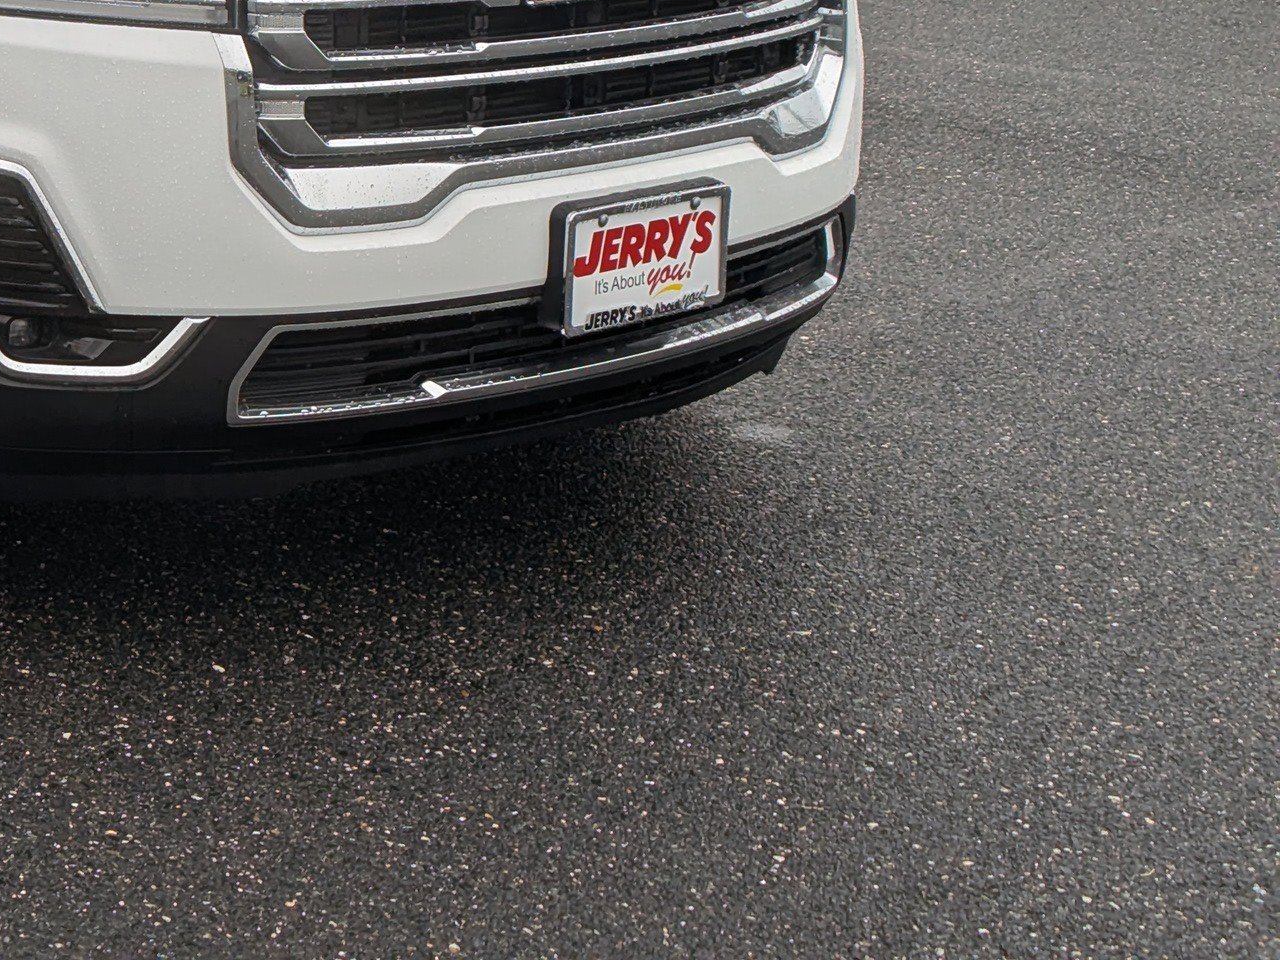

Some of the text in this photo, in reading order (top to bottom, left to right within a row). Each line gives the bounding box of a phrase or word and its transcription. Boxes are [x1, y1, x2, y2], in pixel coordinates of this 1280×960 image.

[573, 209, 717, 278] JERRY'S
[594, 251, 697, 296] It's About you!
[584, 305, 637, 331] JERRY'S
